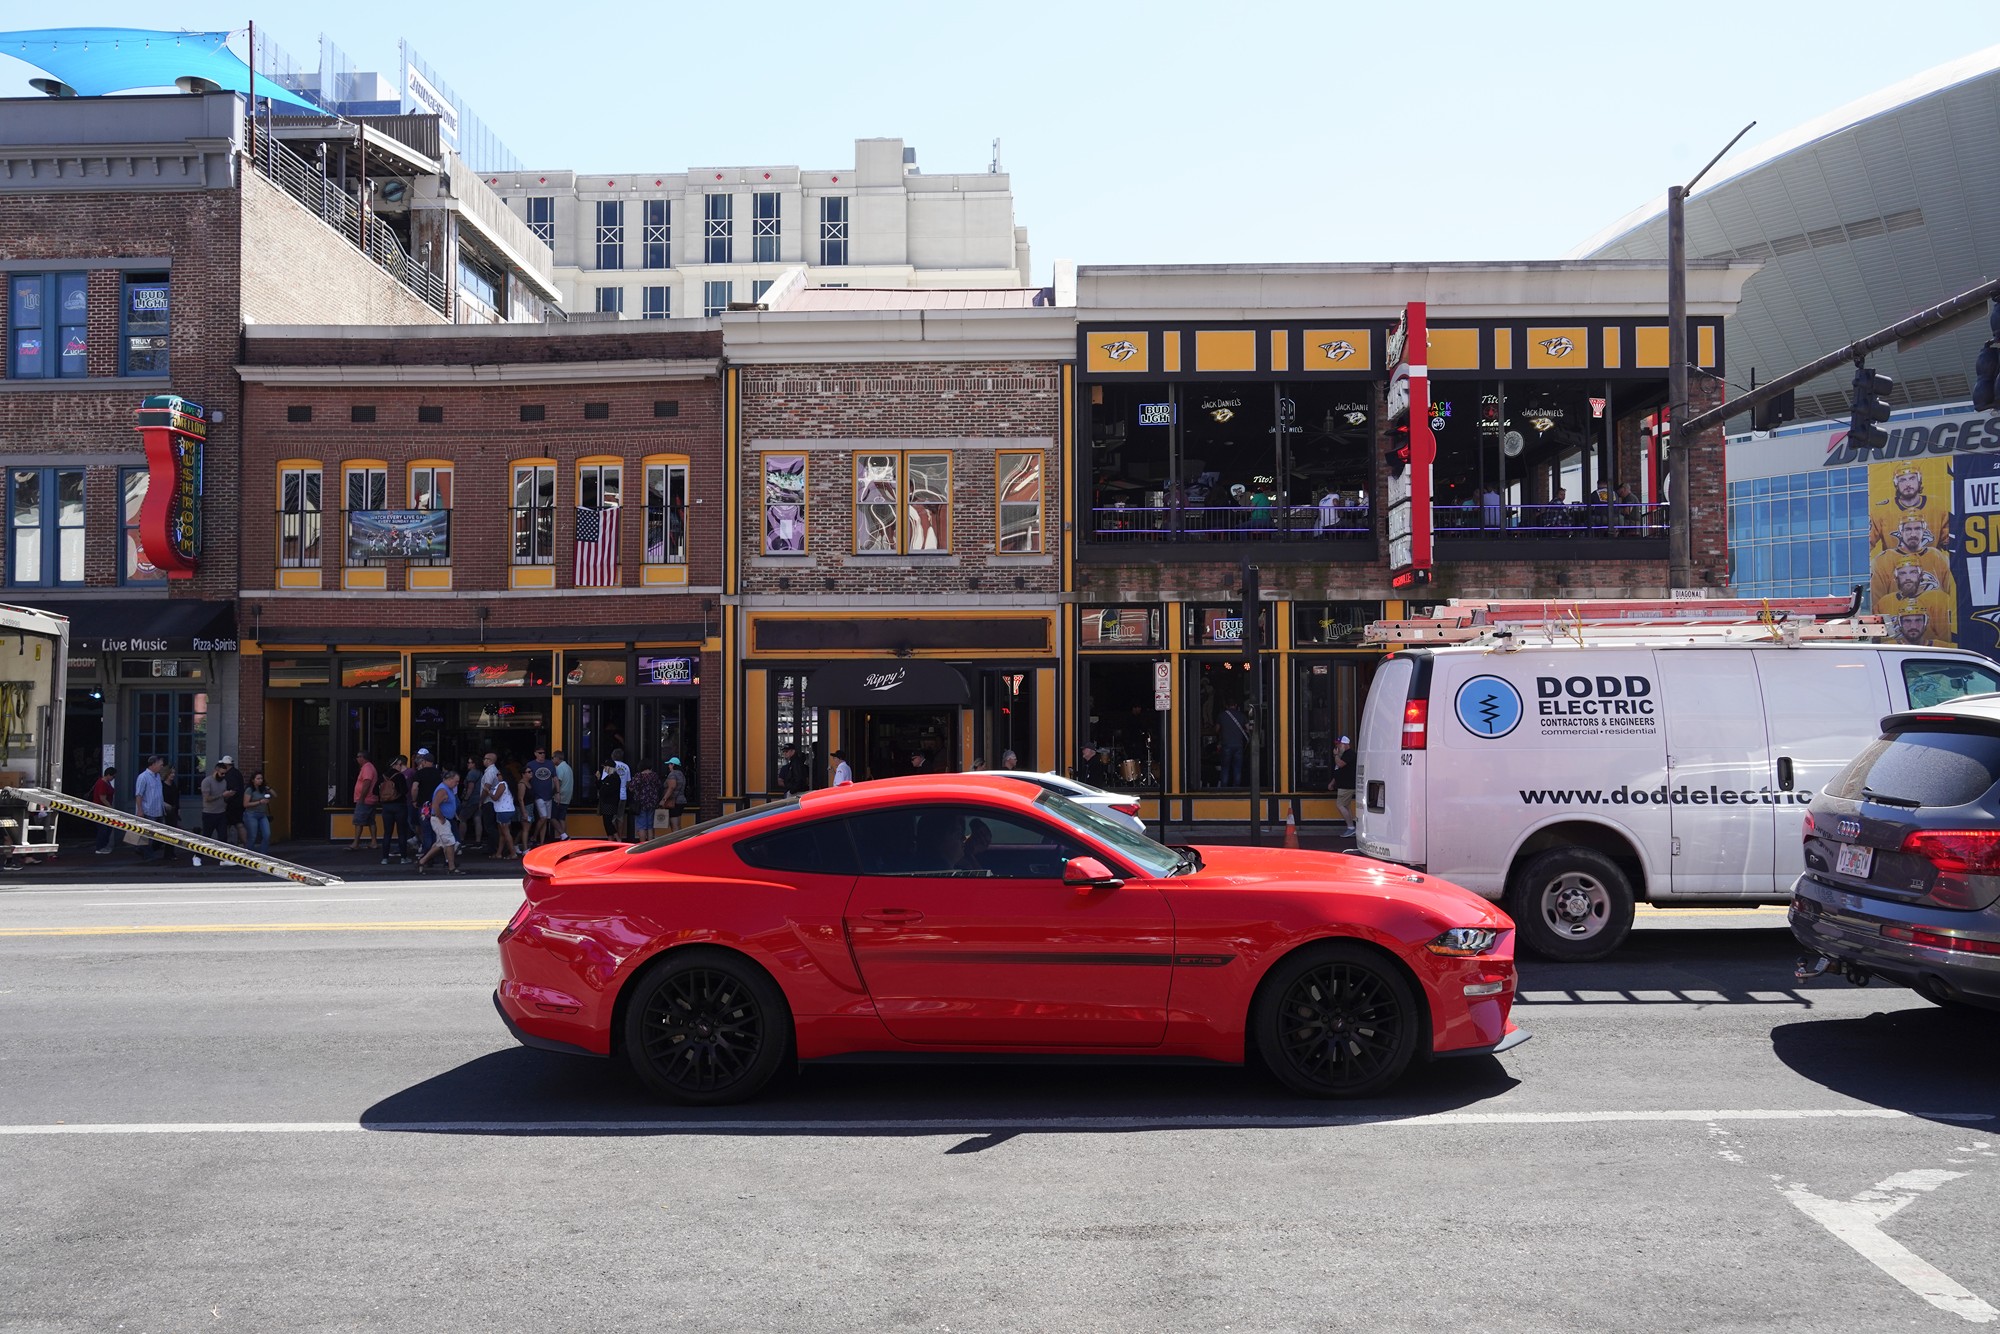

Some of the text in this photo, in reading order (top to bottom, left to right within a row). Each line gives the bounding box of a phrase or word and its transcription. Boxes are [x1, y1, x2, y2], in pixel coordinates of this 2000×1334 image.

[140, 289, 165, 300] BUD
[136, 299, 168, 308] LIGHT
[1202, 397, 1242, 409] JACK DANIEL'S
[1481, 395, 1508, 404] Titos
[1146, 405, 1169, 414] BUD
[1335, 402, 1351, 411] JACK
[1522, 408, 1564, 417] JACK DANIEL'S
[176, 415, 206, 435] MELLOW
[1253, 475, 1274, 484] Tito's
[181, 440, 195, 551] MUSHROOM
[1110, 624, 1136, 641] Lite
[1326, 623, 1352, 640] Lite
[102, 638, 167, 651] Live Music
[193, 638, 237, 651] Pizza Spirits
[659, 661, 683, 670] BUD
[654, 669, 689, 680] LIGHT
[863, 667, 906, 687] Rippy's
[1536, 675, 1651, 698] DODD
[1538, 699, 1654, 715] ELECTRIC
[1540, 717, 1655, 727] CONTRACTORS & ENGINEERS
[1541, 727, 1657, 736] commercial residential
[1519, 785, 1813, 805] www.doddelectric
